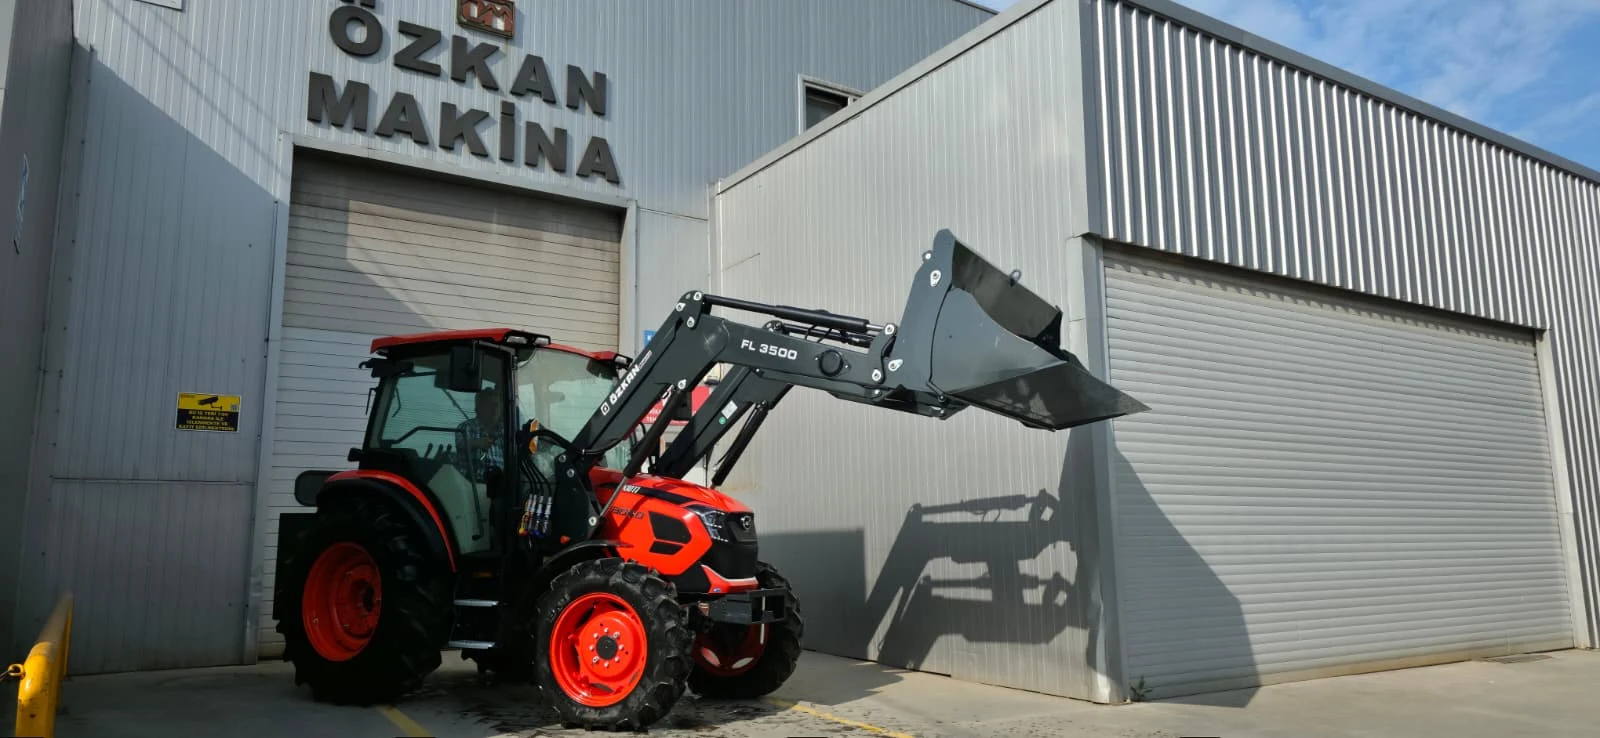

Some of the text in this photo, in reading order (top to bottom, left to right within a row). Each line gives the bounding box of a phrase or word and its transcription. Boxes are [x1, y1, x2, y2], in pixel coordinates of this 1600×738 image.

[329, 0, 607, 116] ÖZKAN
[307, 71, 620, 184] MAKİNA
[741, 339, 798, 360] FL 3500
